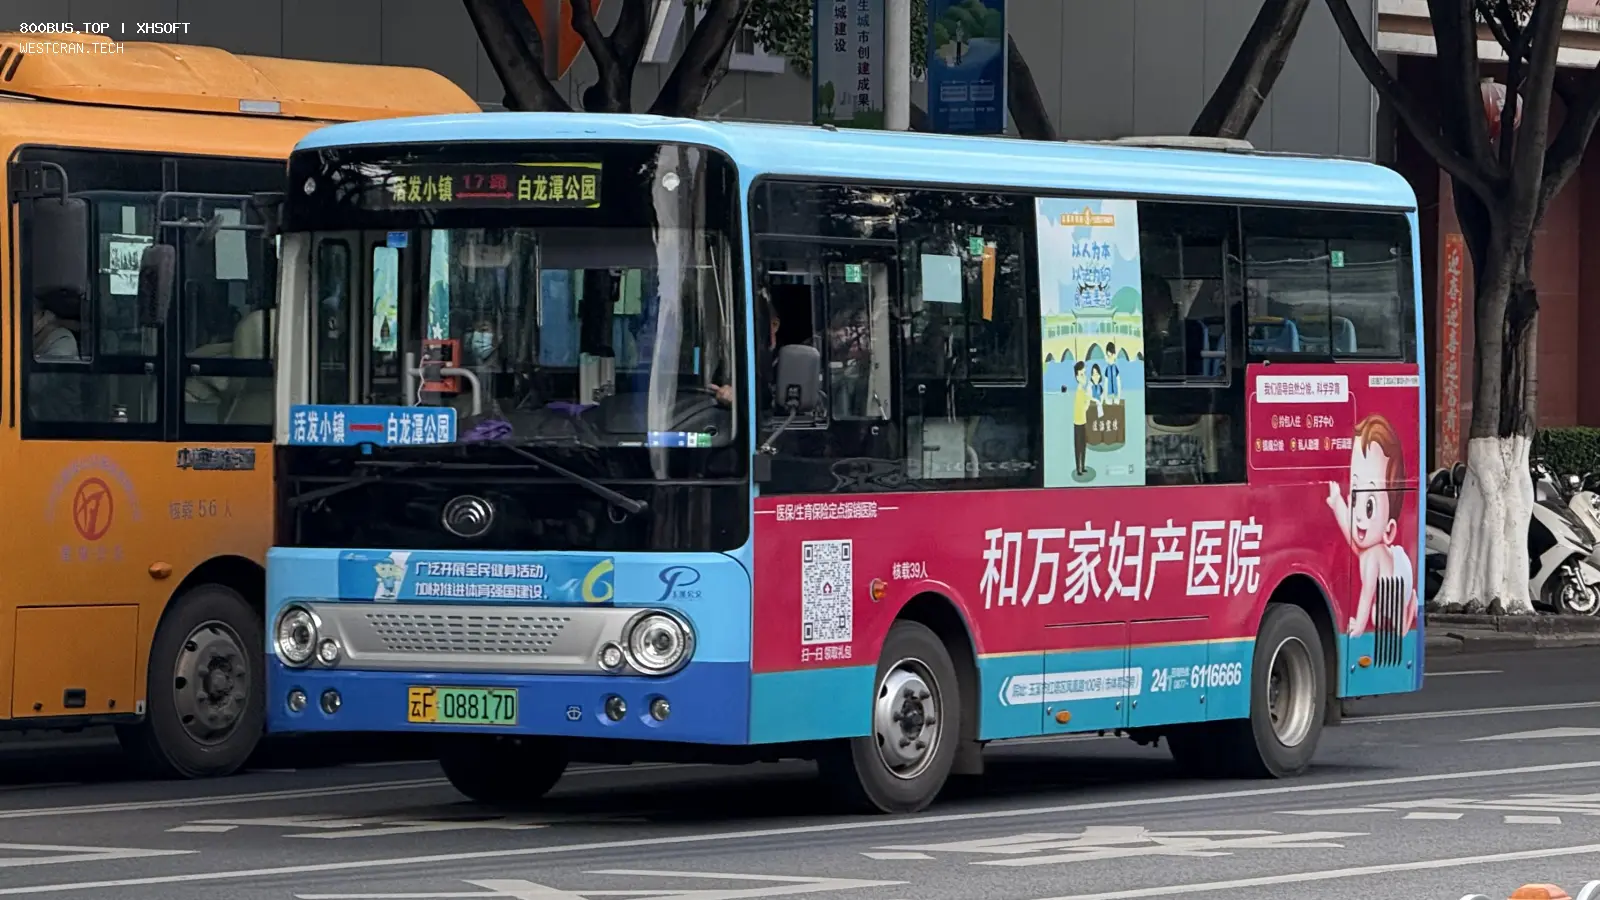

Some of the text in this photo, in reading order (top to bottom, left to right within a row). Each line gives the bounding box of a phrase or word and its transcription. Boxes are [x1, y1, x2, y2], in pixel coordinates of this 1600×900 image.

[834, 0, 848, 53] 城建设
[857, 0, 871, 107] 生城市创建成果
[393, 175, 453, 202] 活发小镇
[518, 174, 597, 202] 白龙潭公园
[1071, 241, 1111, 260] 以人为本
[293, 411, 450, 444] 活发小镇 白龙潭公园
[892, 561, 929, 580] 核载39人
[980, 516, 1263, 609] 和万家妇产医院
[1190, 661, 1242, 689] 6116666
